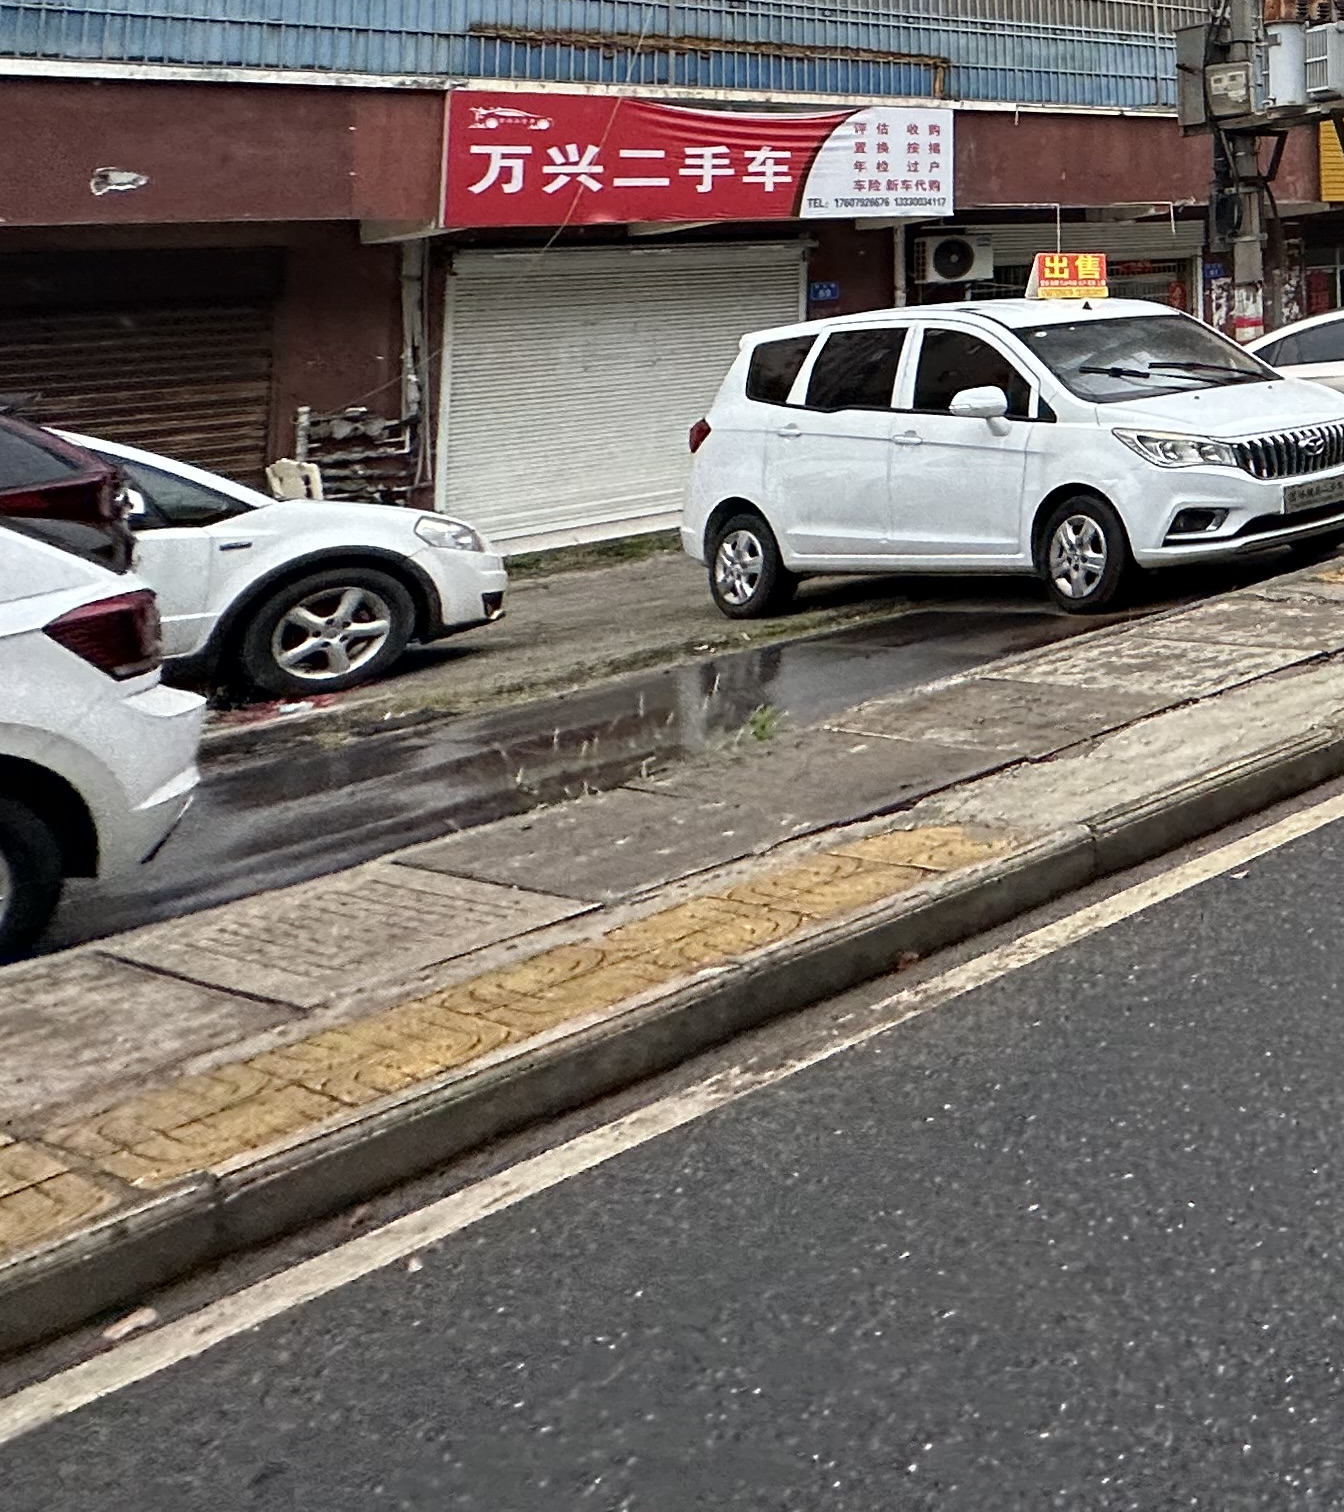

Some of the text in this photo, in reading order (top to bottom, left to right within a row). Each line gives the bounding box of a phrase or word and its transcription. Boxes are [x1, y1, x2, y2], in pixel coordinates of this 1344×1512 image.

[853, 122, 941, 137] 评估 收购
[853, 141, 941, 155] 置换 按揭
[467, 143, 794, 196] 万兴二手车
[853, 160, 940, 173] 年检 过户
[852, 179, 941, 192] 车险 新车代购
[1043, 254, 1101, 279] 出售
